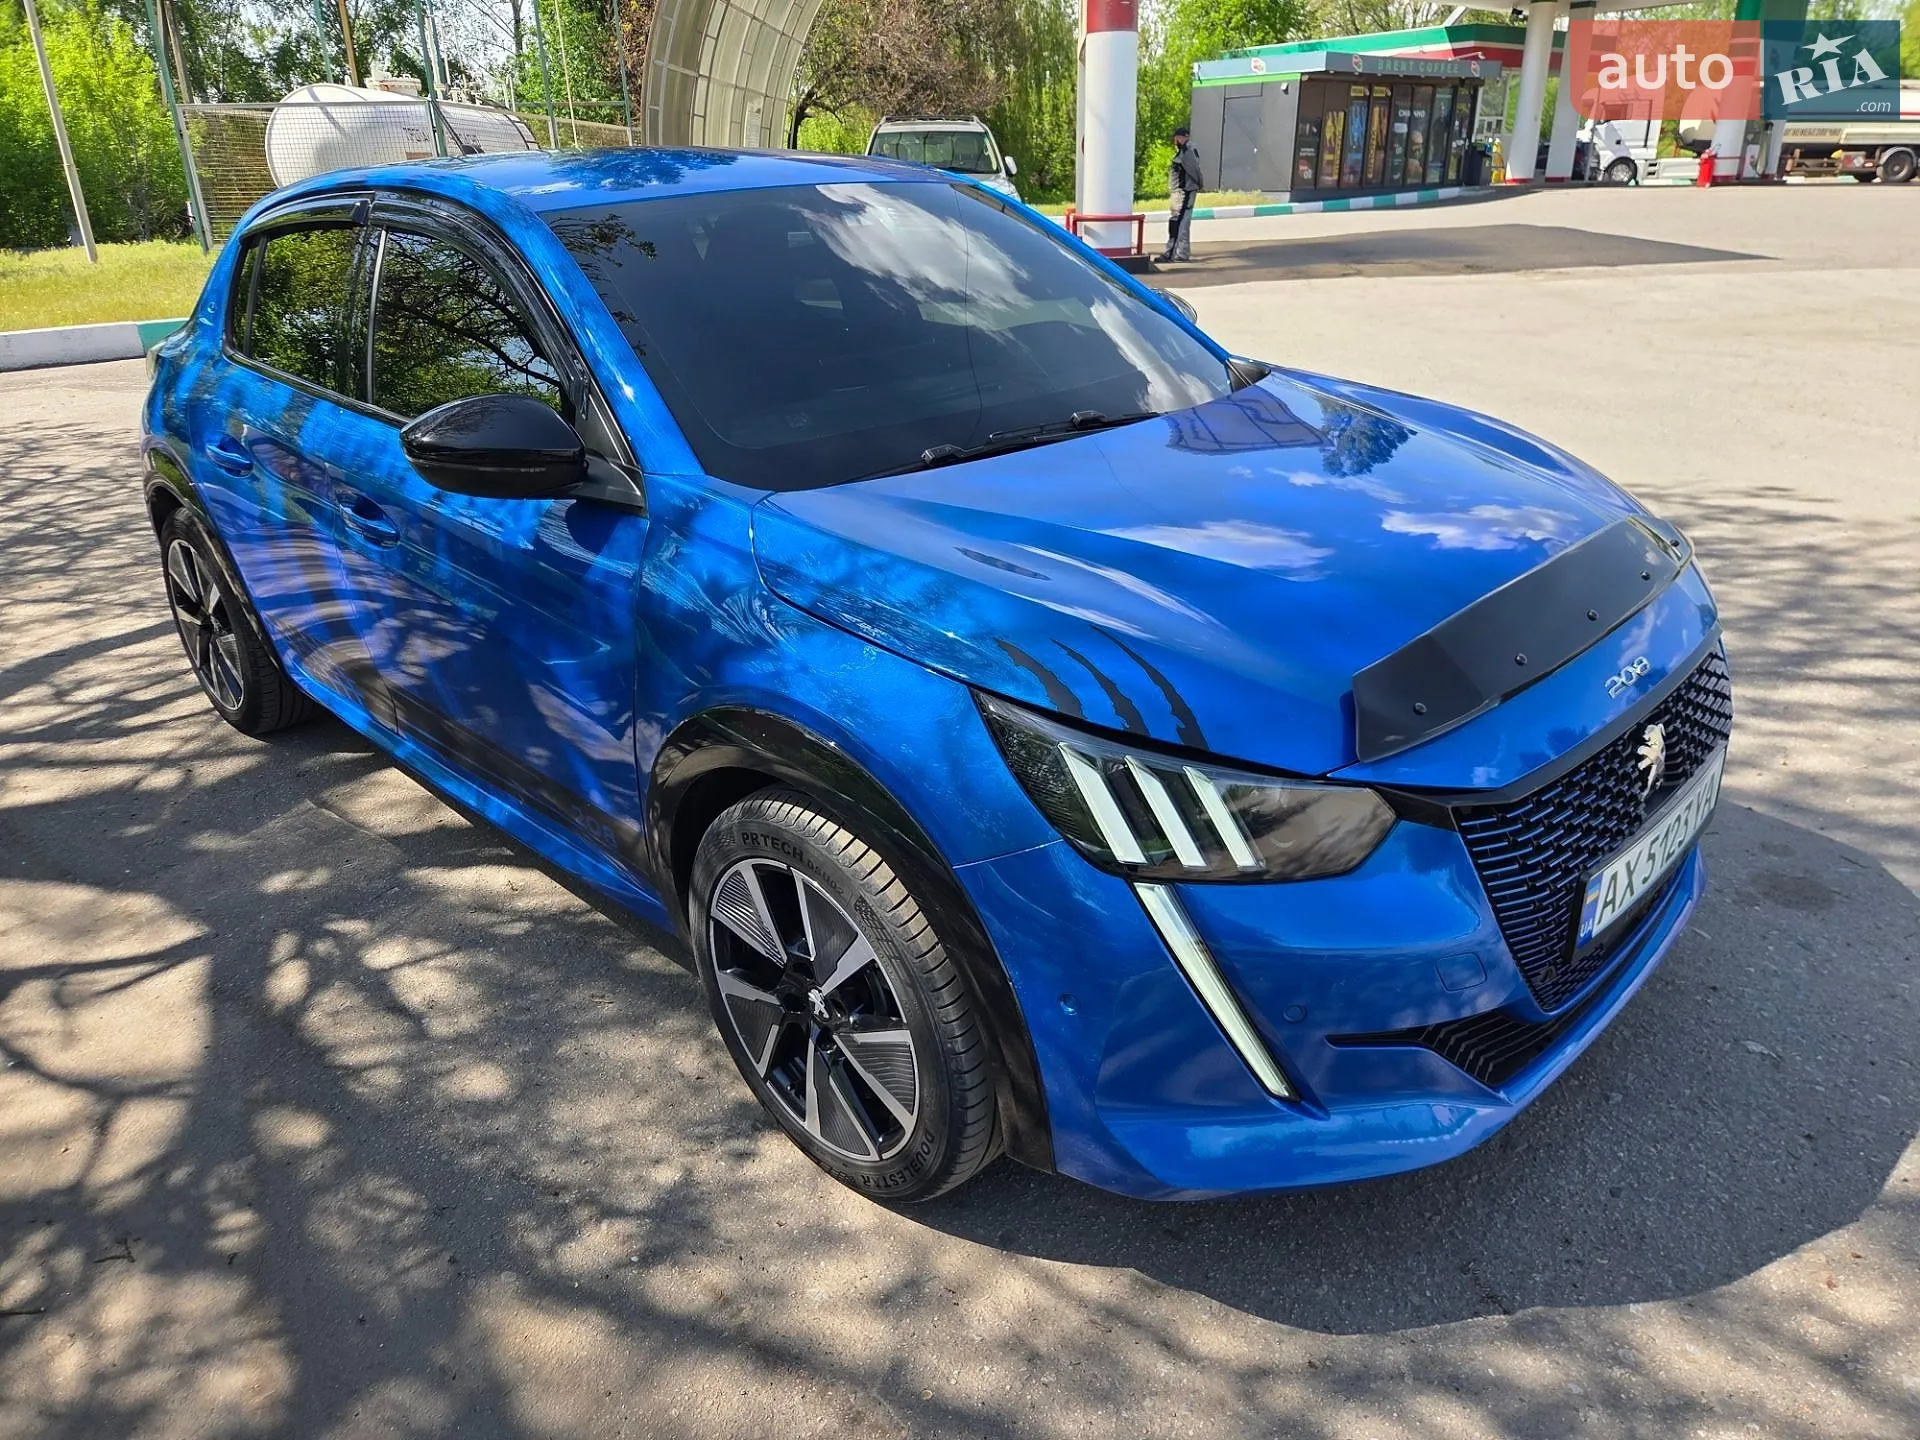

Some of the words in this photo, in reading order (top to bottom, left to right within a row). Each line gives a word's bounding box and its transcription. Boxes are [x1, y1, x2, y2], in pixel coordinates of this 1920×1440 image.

[1377, 59, 1414, 72] BRENT
[1419, 61, 1460, 74] COFFEE
[1605, 656, 1650, 699] 208
[1597, 850, 1643, 926] AX
[1642, 801, 1693, 886] 5123
[1580, 918, 1594, 938] UA
[860, 1128, 935, 1188] DOUBLESTAR
